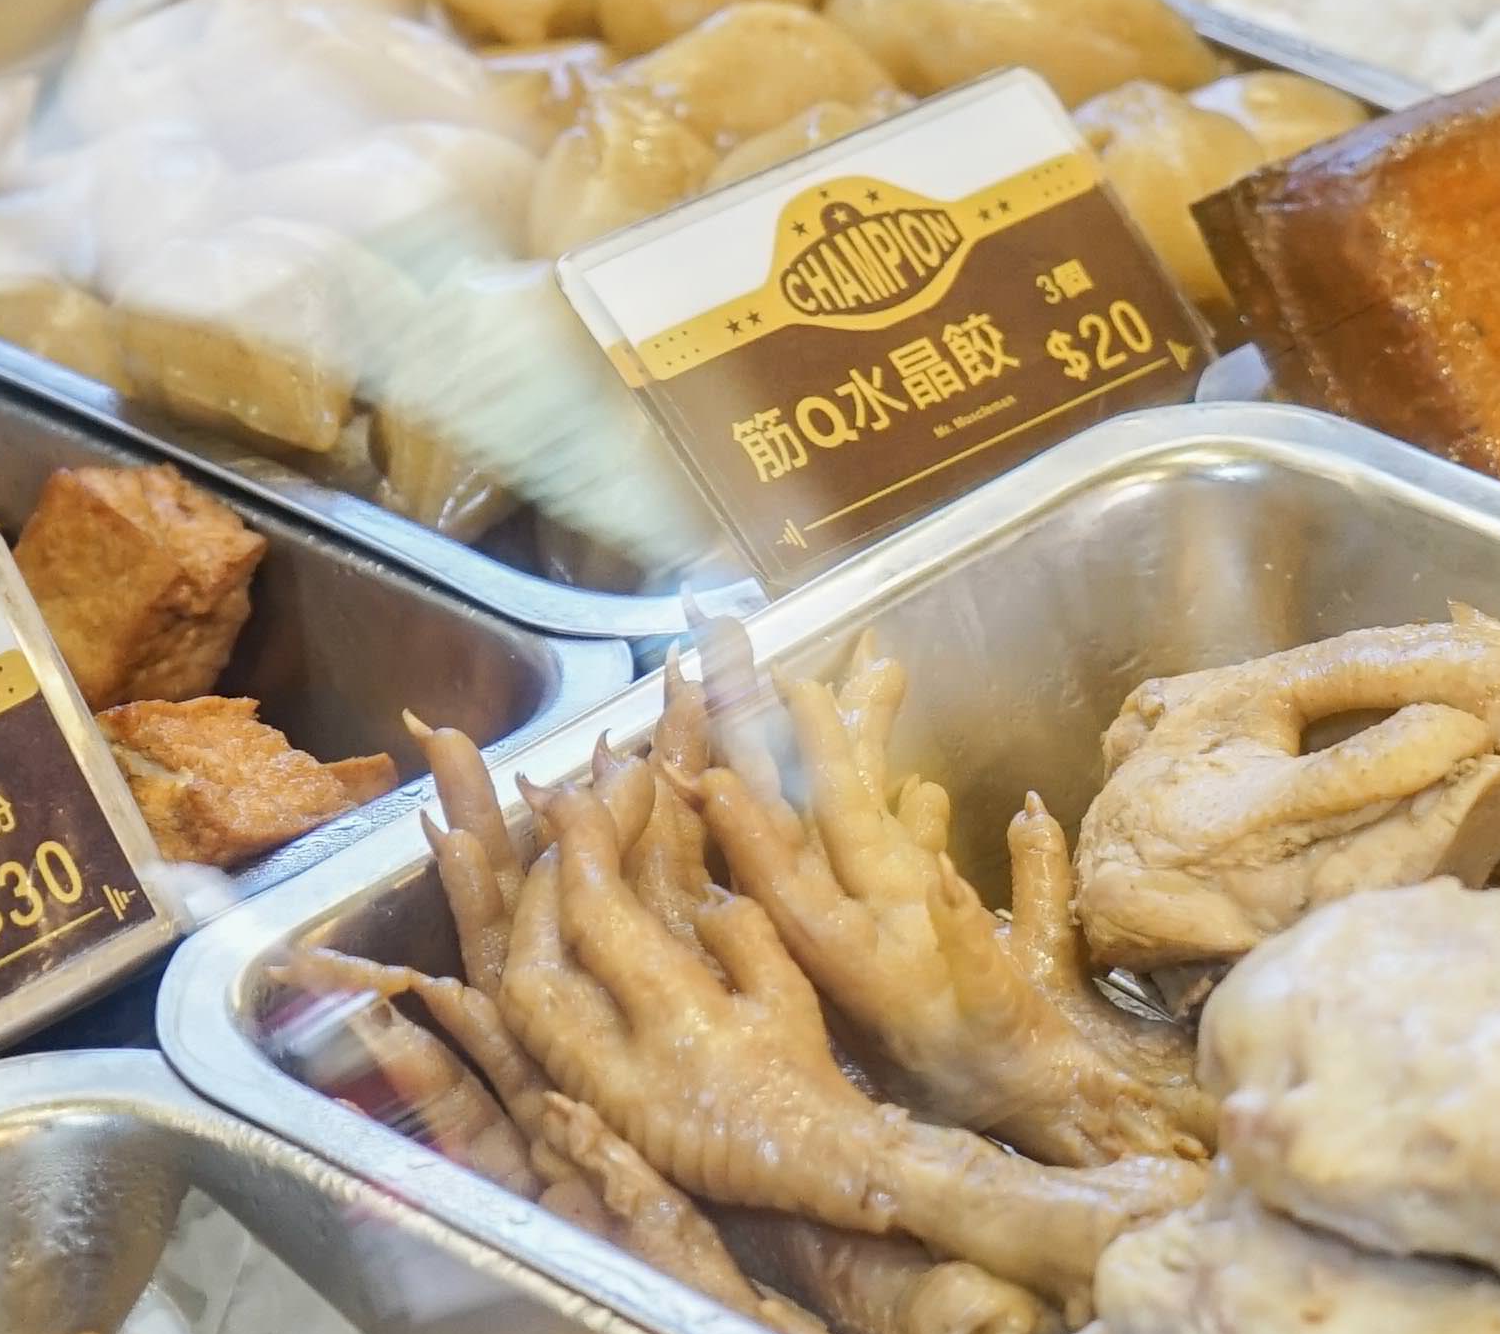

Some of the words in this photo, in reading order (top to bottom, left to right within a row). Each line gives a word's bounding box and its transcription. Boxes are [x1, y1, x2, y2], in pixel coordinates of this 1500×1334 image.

[784, 209, 961, 315] CHAMPION
[1046, 300, 1153, 381] $20
[730, 312, 1020, 484] 筋Q水晶餃
